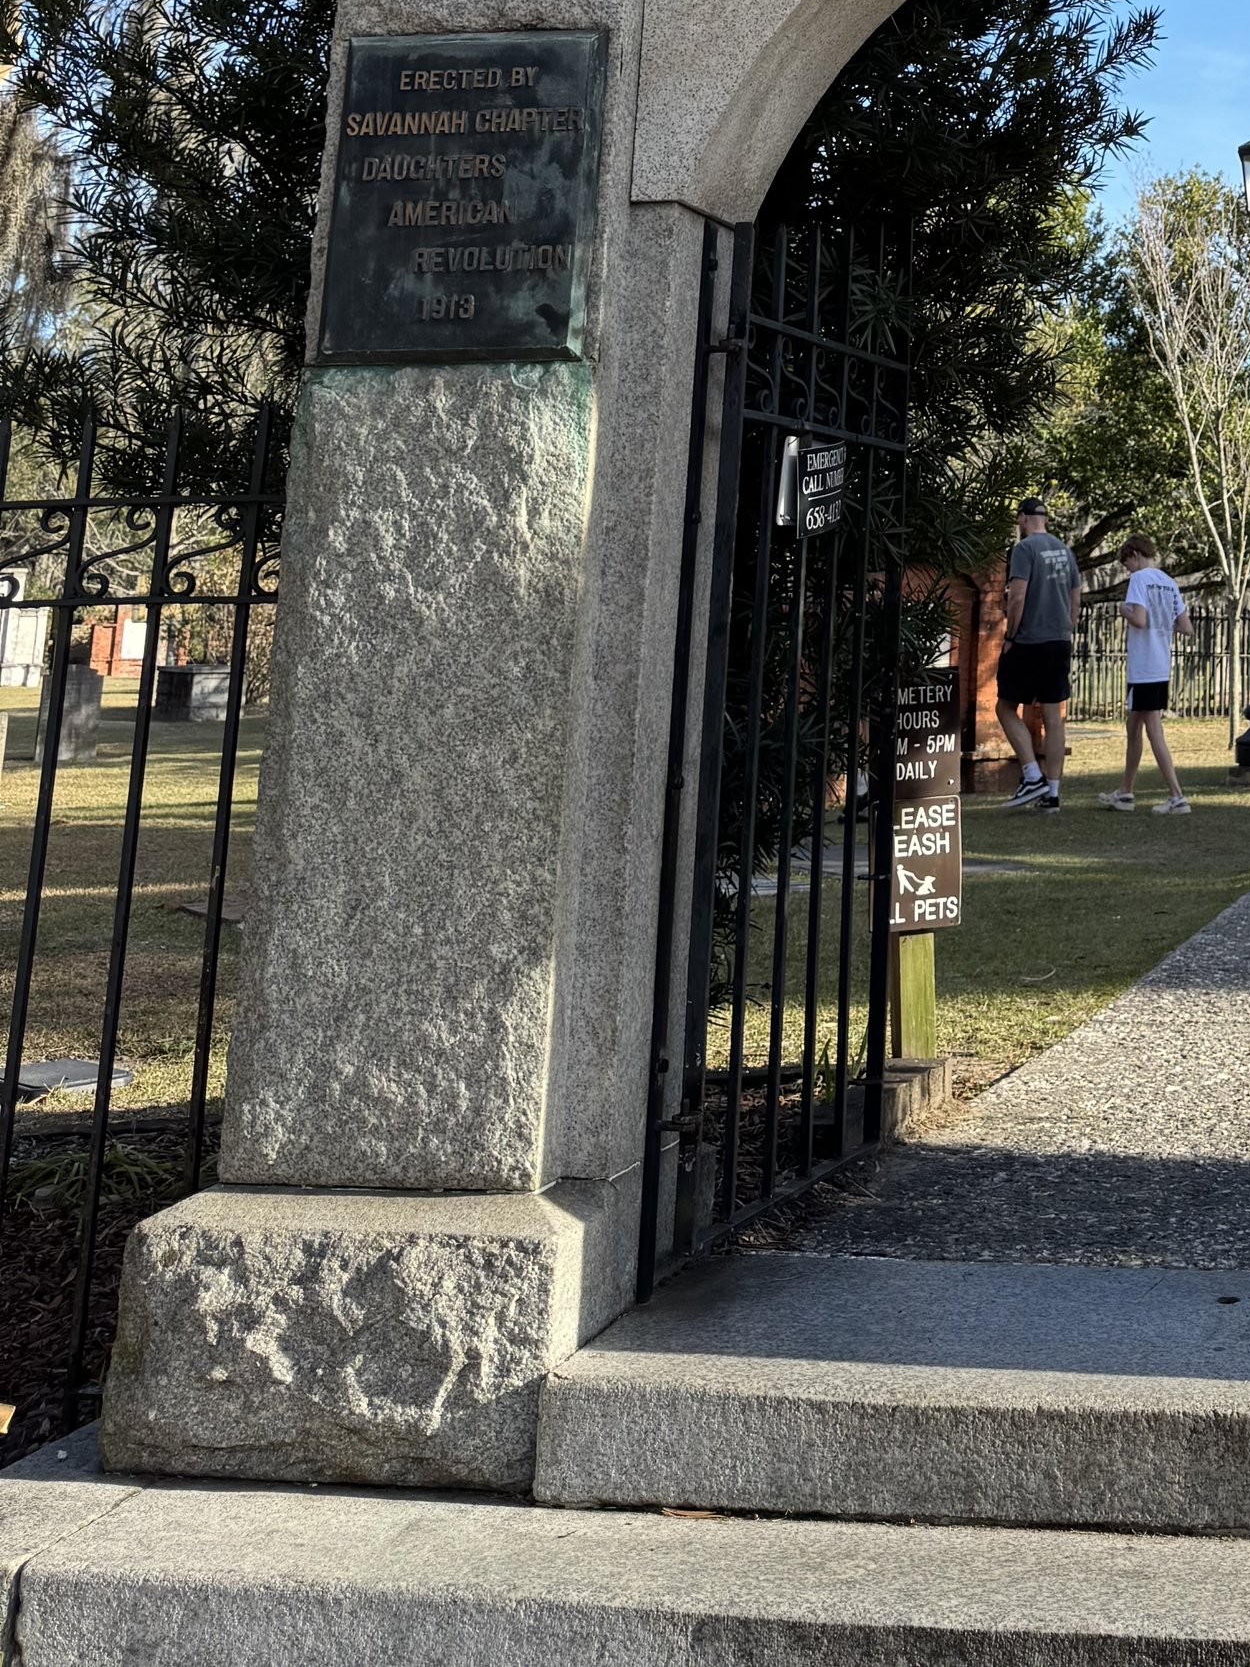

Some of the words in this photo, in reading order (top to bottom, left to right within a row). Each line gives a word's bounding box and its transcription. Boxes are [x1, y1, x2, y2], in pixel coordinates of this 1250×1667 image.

[399, 67, 502, 92] ERECTED
[510, 66, 539, 88] BY
[346, 110, 466, 136] SAVANNAH
[474, 107, 585, 134] CHAPTER
[361, 153, 507, 182] DAUGHTERS
[387, 200, 516, 227] AMERICAN
[413, 244, 573, 273] REVOLUTION
[419, 294, 476, 321] 1913
[802, 474, 823, 495] CALL
[897, 684, 953, 705] METERY
[926, 733, 956, 754] 5PM
[896, 759, 938, 781] DAILY
[894, 832, 950, 858] EASH
[914, 896, 958, 922] PETS
